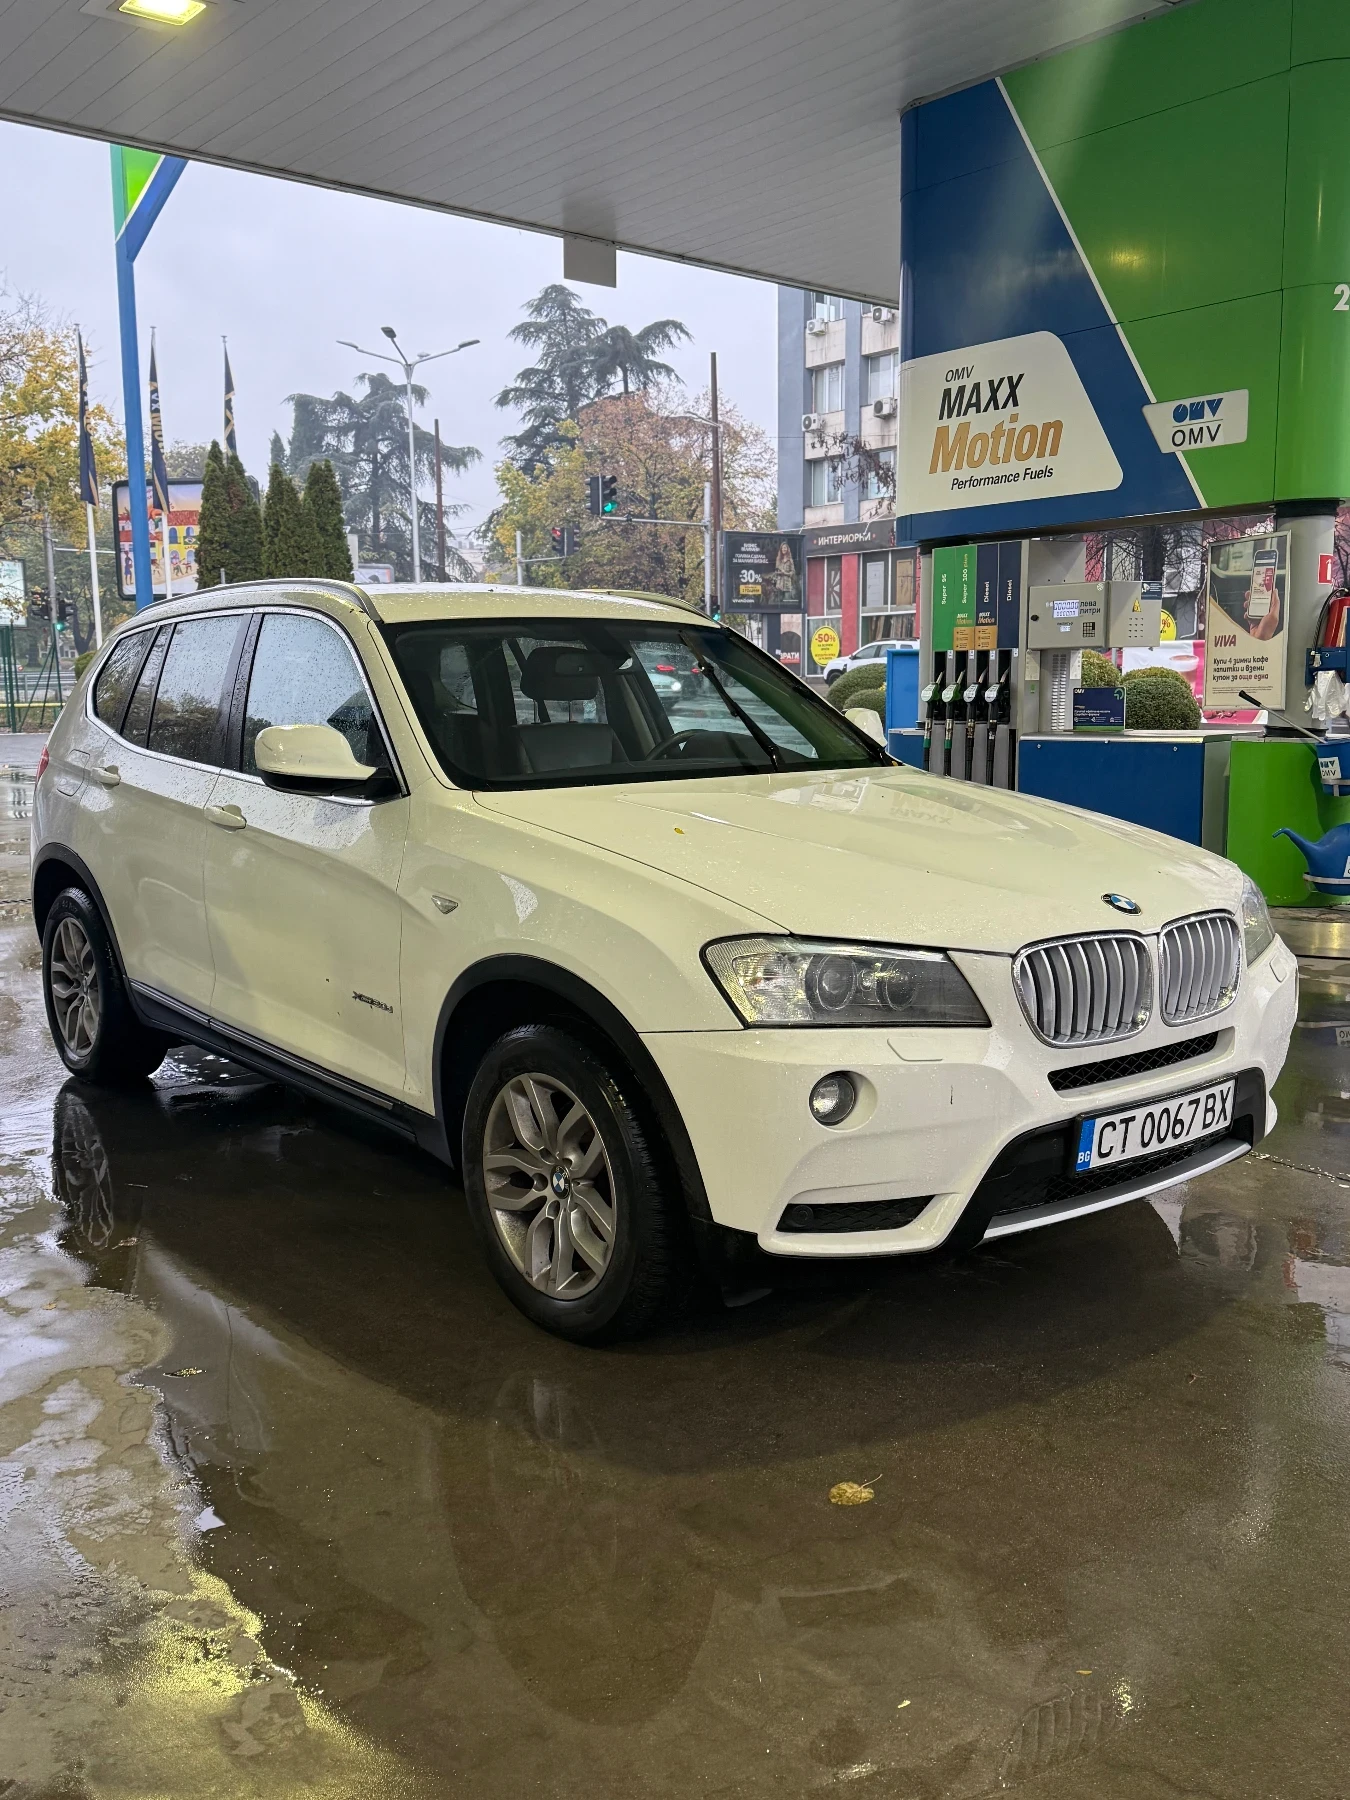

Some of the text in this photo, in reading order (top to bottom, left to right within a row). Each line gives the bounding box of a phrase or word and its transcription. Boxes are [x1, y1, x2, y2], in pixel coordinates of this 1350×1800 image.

[945, 365, 975, 382] OMV
[938, 373, 1025, 420] MAXX
[929, 413, 1063, 474] Motion
[1171, 424, 1222, 447] OMV
[951, 465, 1054, 490] Performance Fuels
[818, 532, 871, 546] ИНТЕРИОРНИ
[739, 569, 763, 583] -30%
[815, 633, 836, 643] -50%
[1214, 634, 1237, 648] VIVA
[1097, 1086, 1232, 1158] CT 0067 BX
[1077, 1150, 1091, 1164] BG
